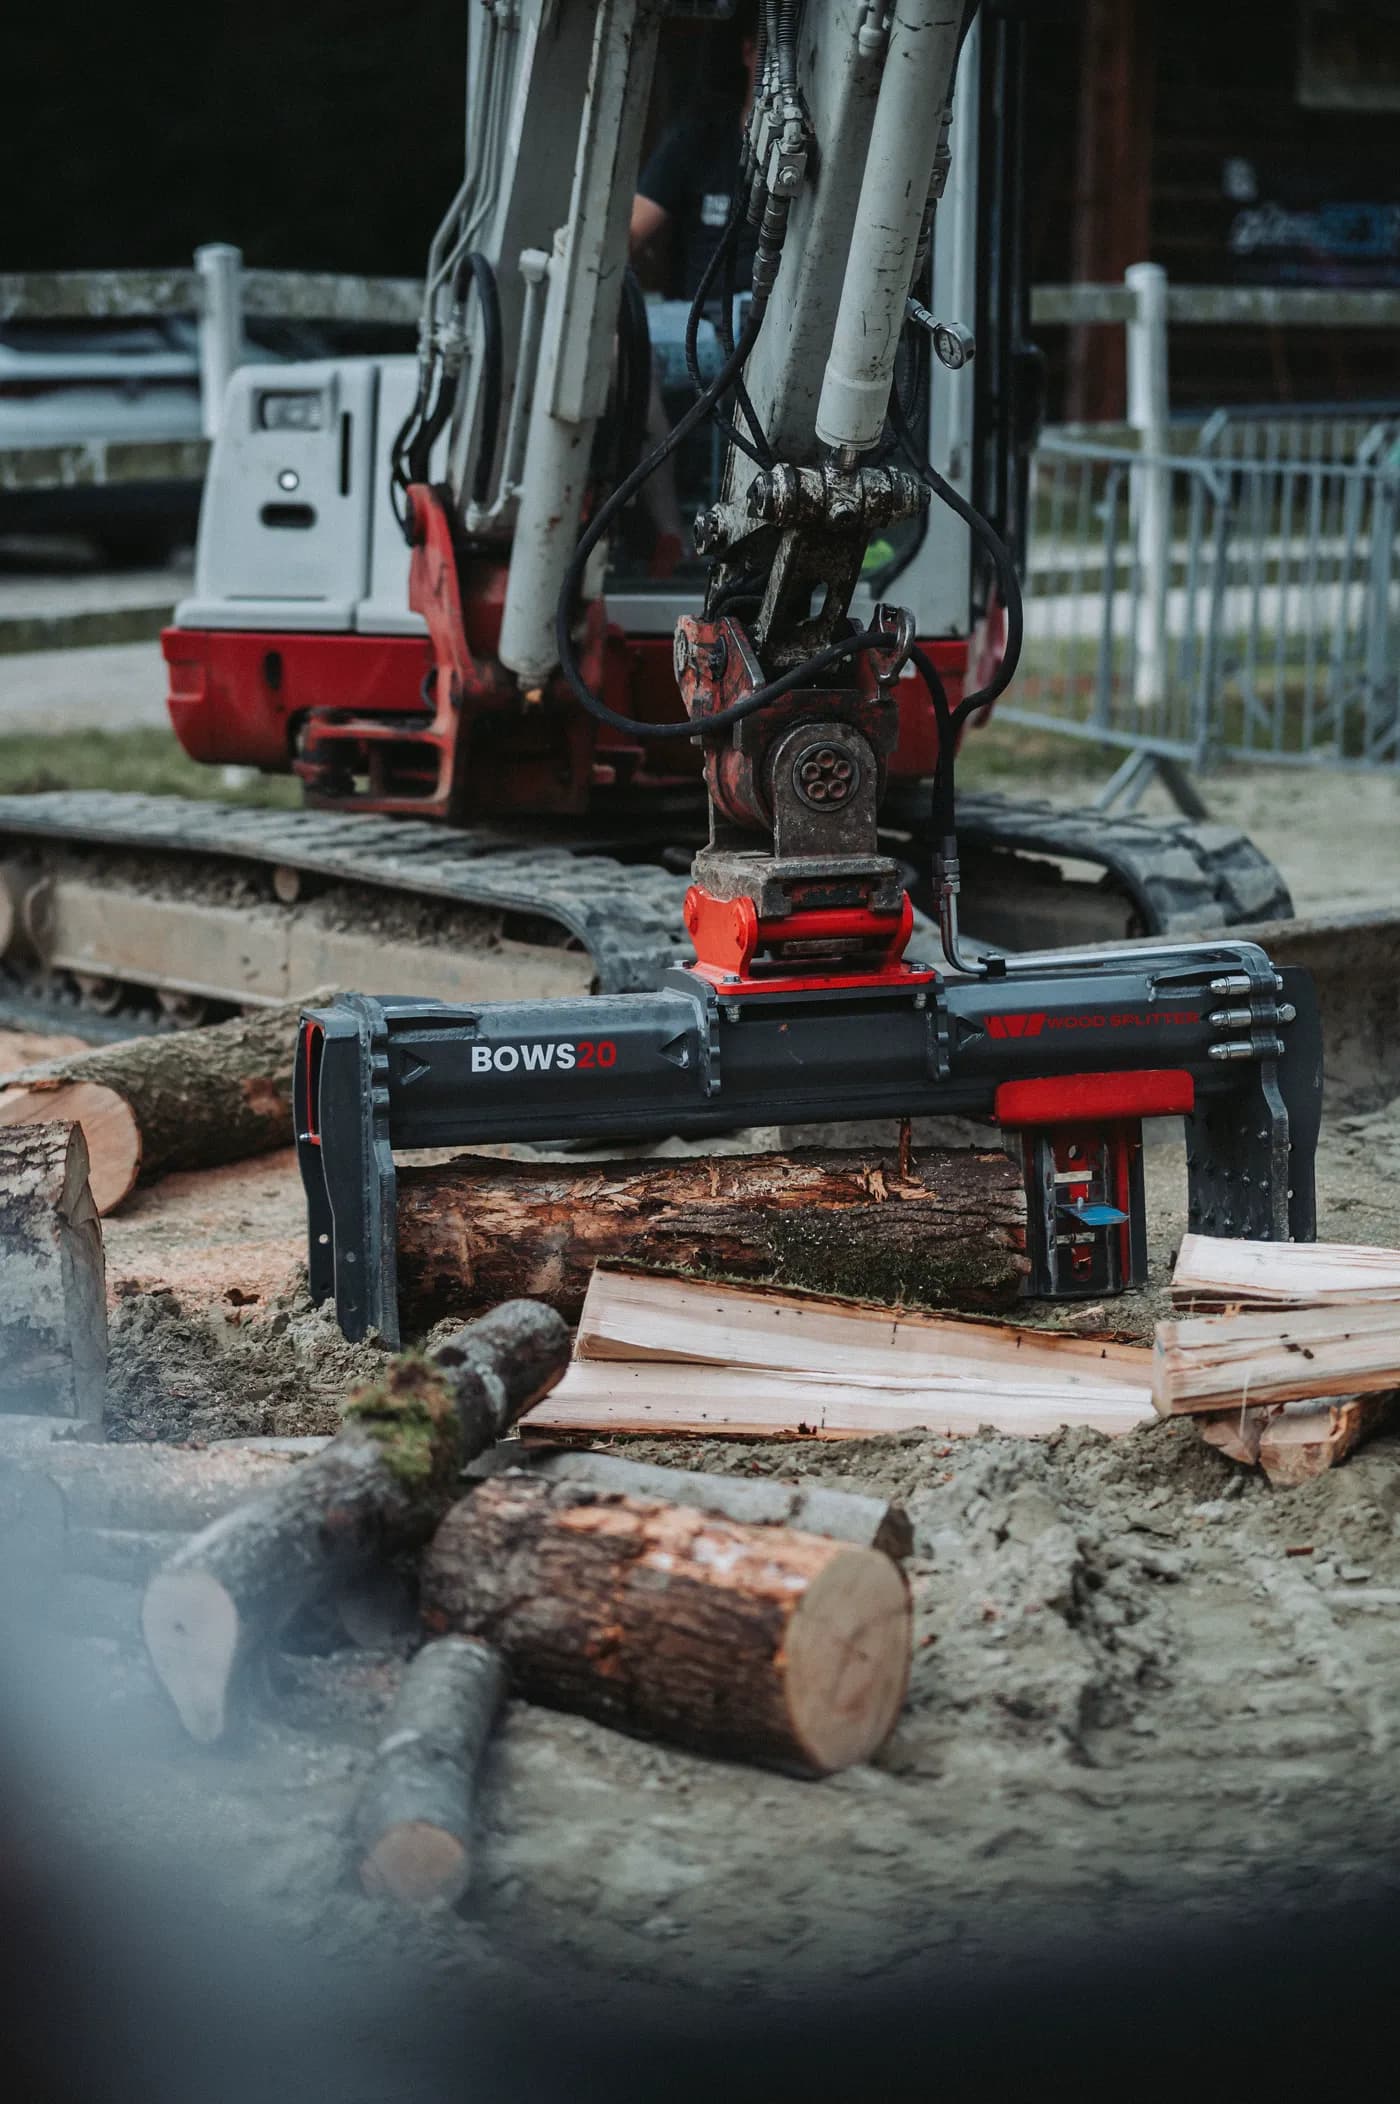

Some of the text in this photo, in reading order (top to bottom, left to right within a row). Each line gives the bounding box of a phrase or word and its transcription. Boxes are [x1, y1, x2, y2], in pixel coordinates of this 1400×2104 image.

[1048, 1014, 1105, 1029] WOOD
[1109, 1011, 1199, 1027] SPLITTER
[471, 1040, 617, 1073] BOWS20
